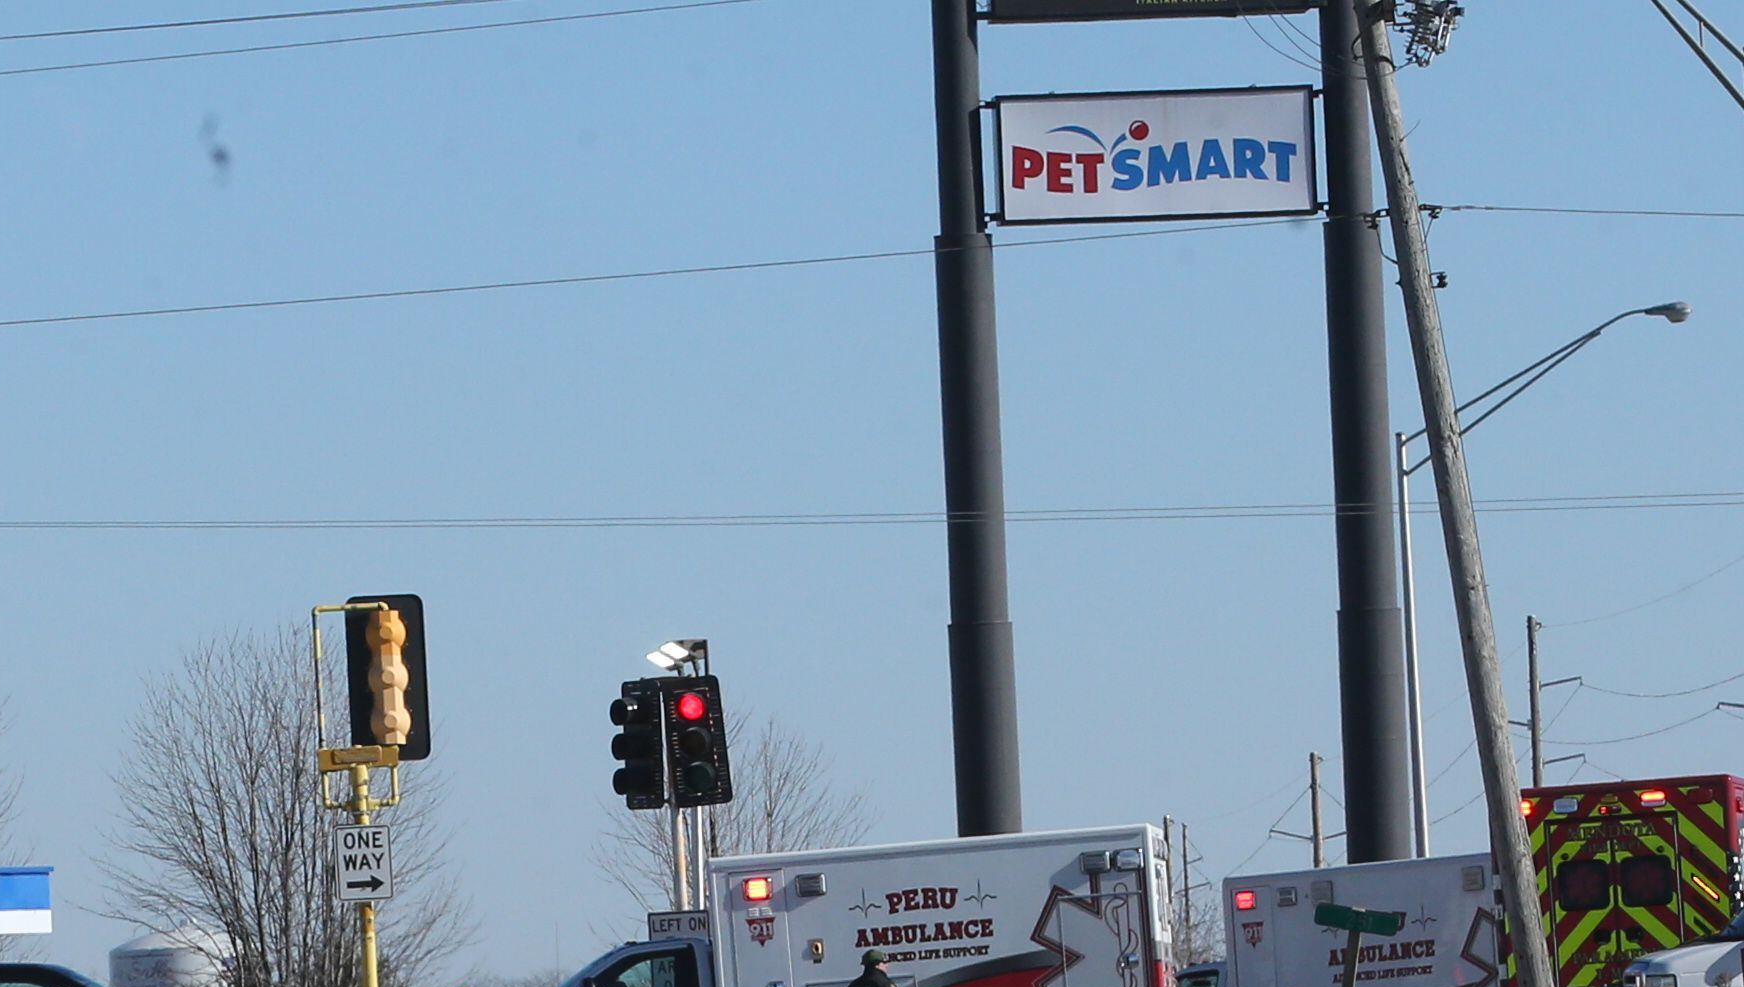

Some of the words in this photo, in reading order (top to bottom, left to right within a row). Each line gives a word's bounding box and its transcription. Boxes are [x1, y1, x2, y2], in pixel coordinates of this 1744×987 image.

[343, 831, 384, 850] ONE
[343, 852, 384, 871] WAY
[885, 887, 959, 915] PERU
[652, 918, 682, 933] LEFT
[688, 917, 707, 931] ON
[750, 922, 773, 937] 911
[855, 918, 994, 948] AMBULANCE
[1245, 926, 1262, 938] 911
[918, 949, 942, 961] LIFE
[942, 945, 990, 959] SUPPORT
[1332, 969, 1377, 984] ADNCED
[1396, 965, 1433, 978] SUPPORT
